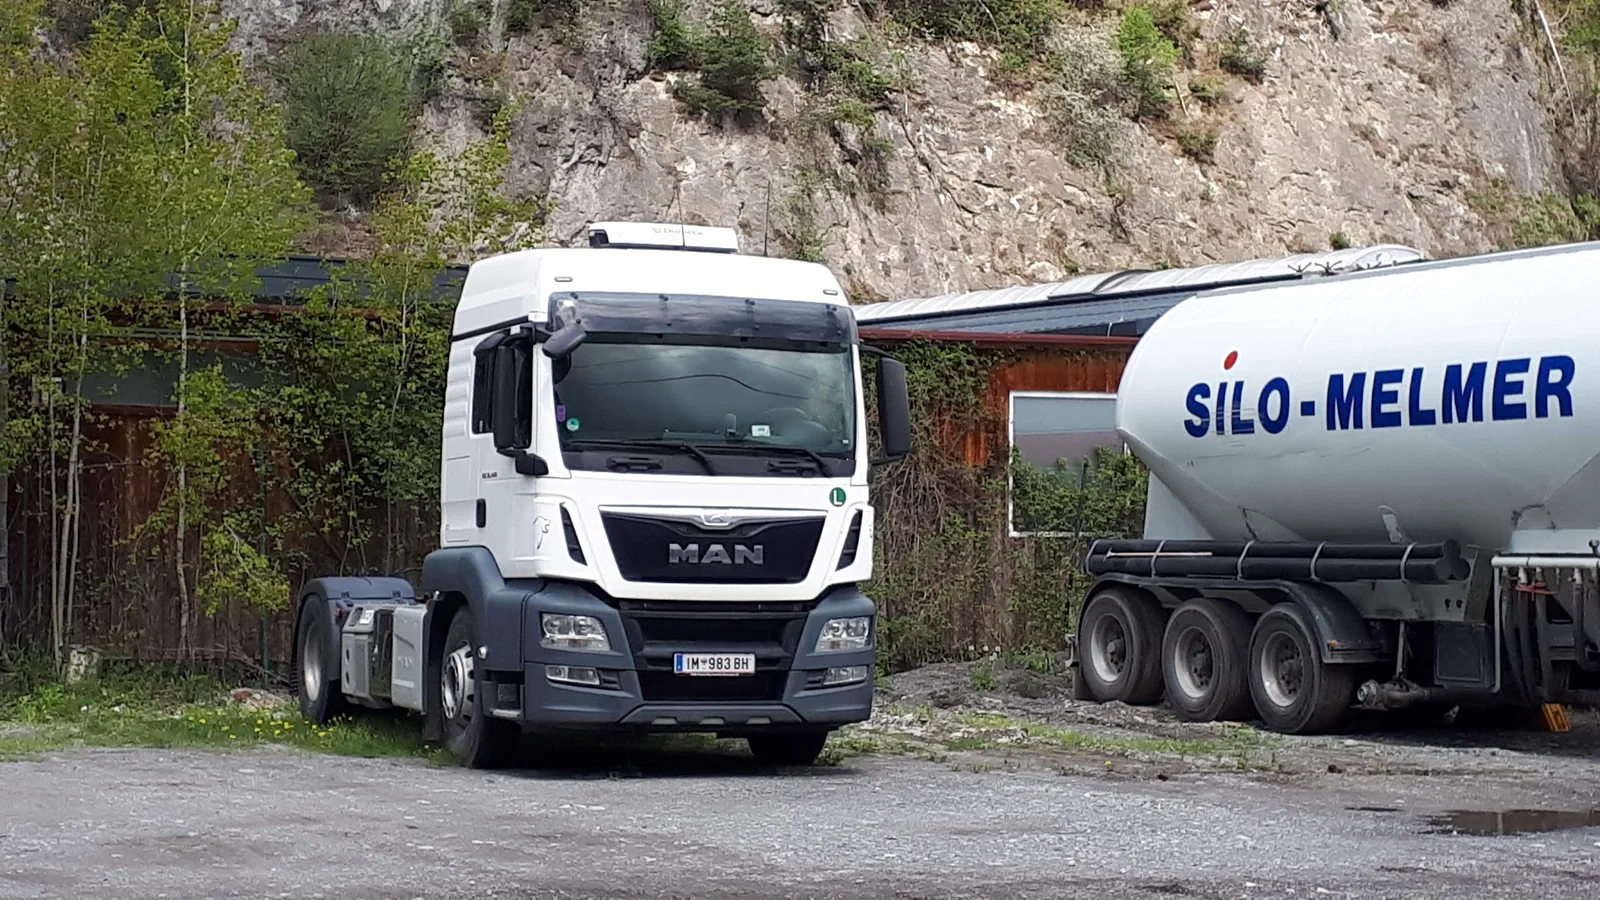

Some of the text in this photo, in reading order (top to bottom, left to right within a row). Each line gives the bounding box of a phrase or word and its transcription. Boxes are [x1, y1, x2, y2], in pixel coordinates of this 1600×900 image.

[833, 489, 843, 505] L
[669, 543, 764, 564] MAN
[687, 657, 749, 670] IM 983 BH
